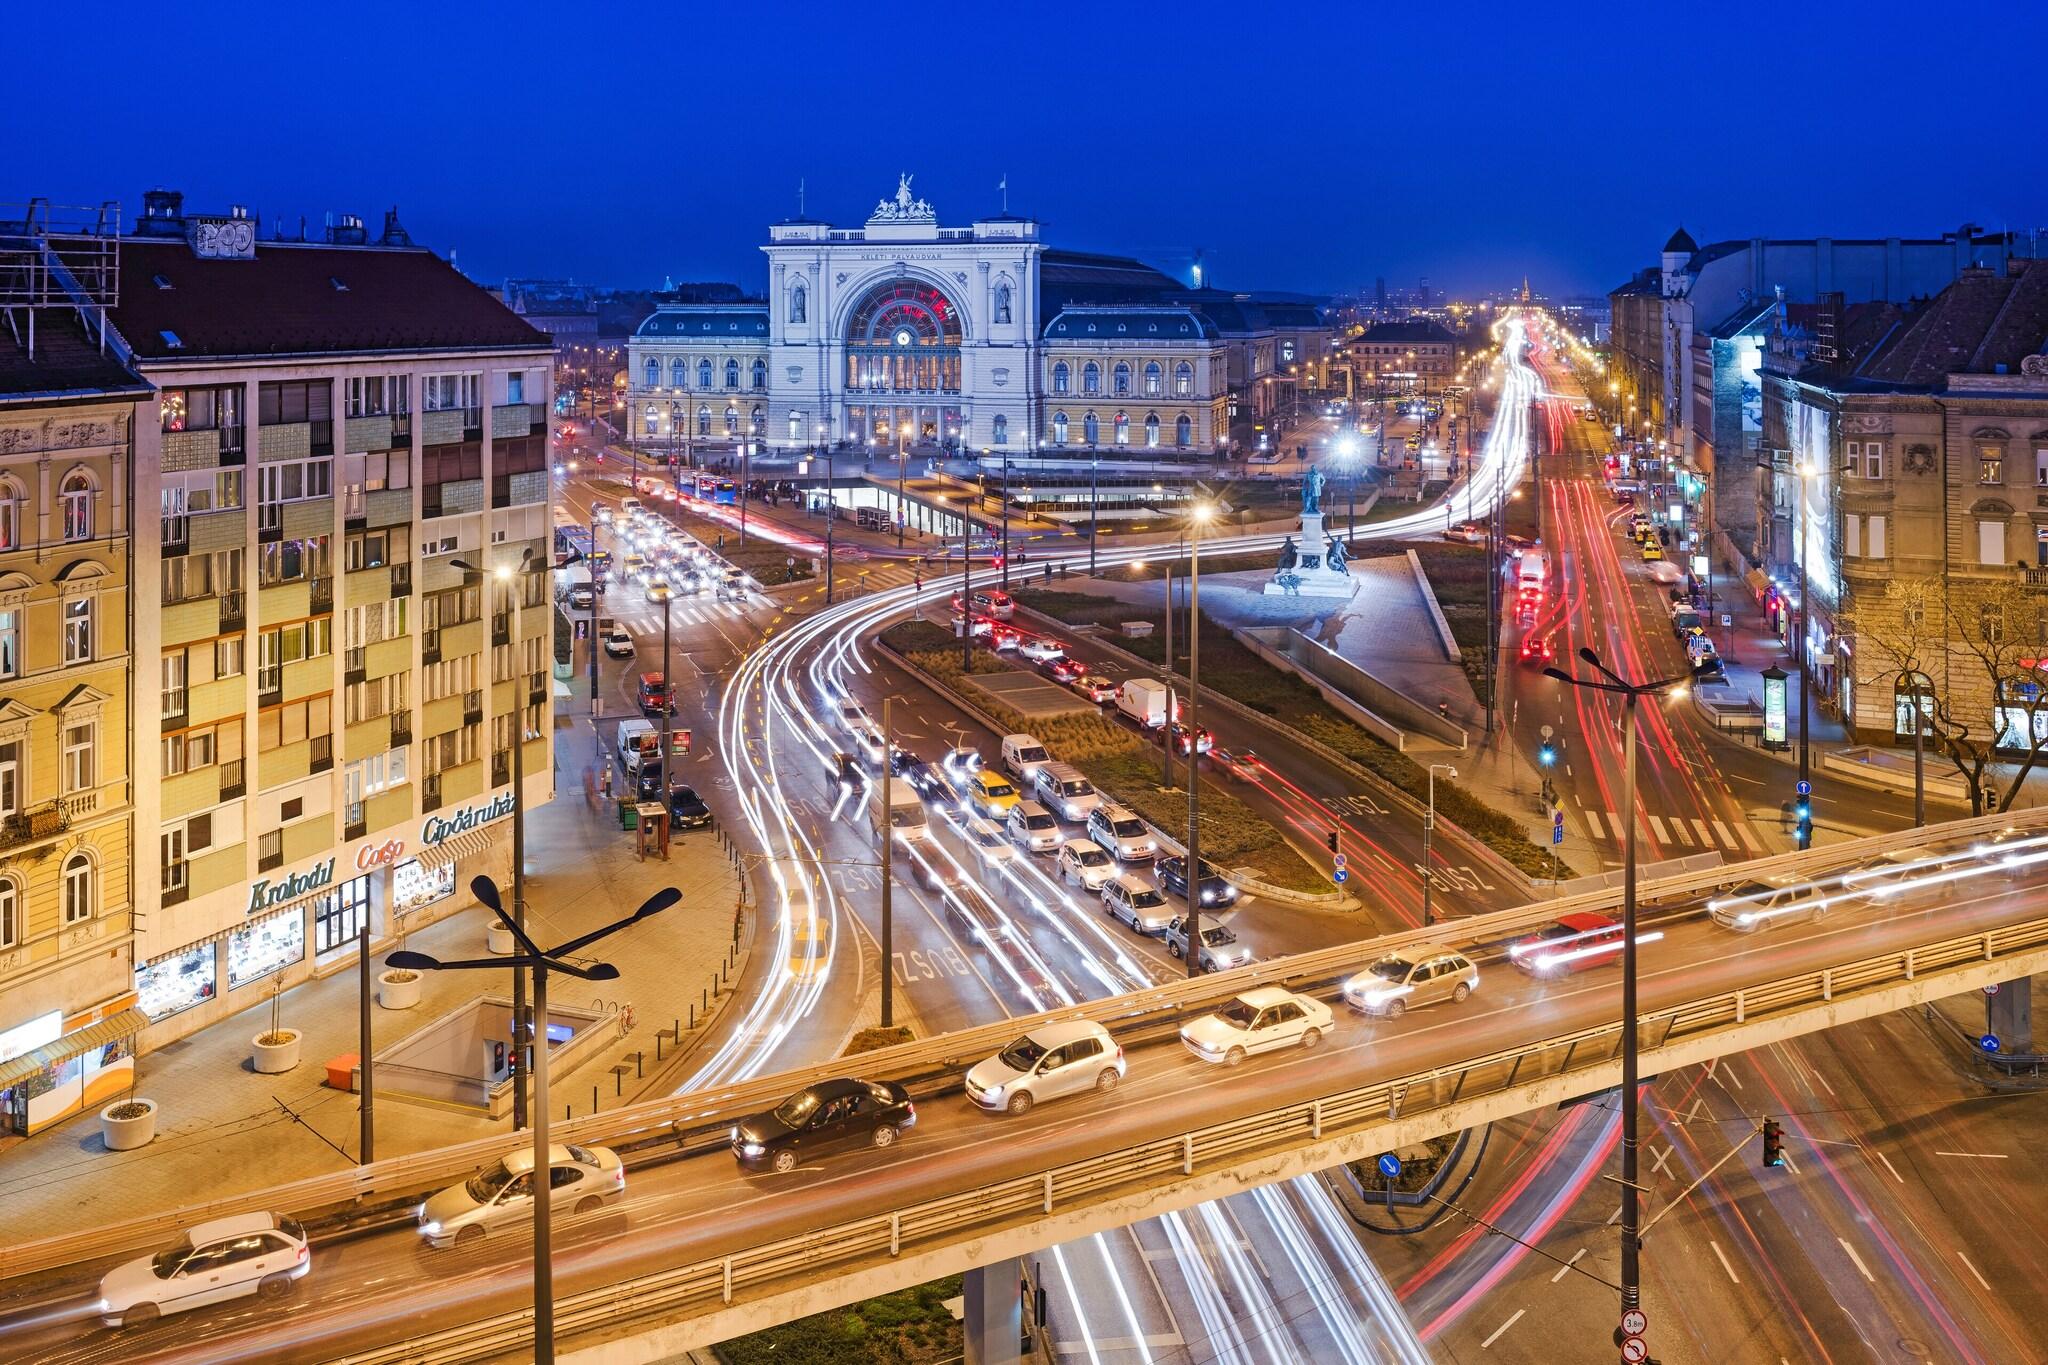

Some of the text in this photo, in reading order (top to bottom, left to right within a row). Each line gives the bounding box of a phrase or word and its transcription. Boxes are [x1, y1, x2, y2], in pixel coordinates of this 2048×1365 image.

[356, 839, 405, 870] Corso
[247, 857, 336, 914] Krokodil
[892, 947, 970, 982] BUSZ
